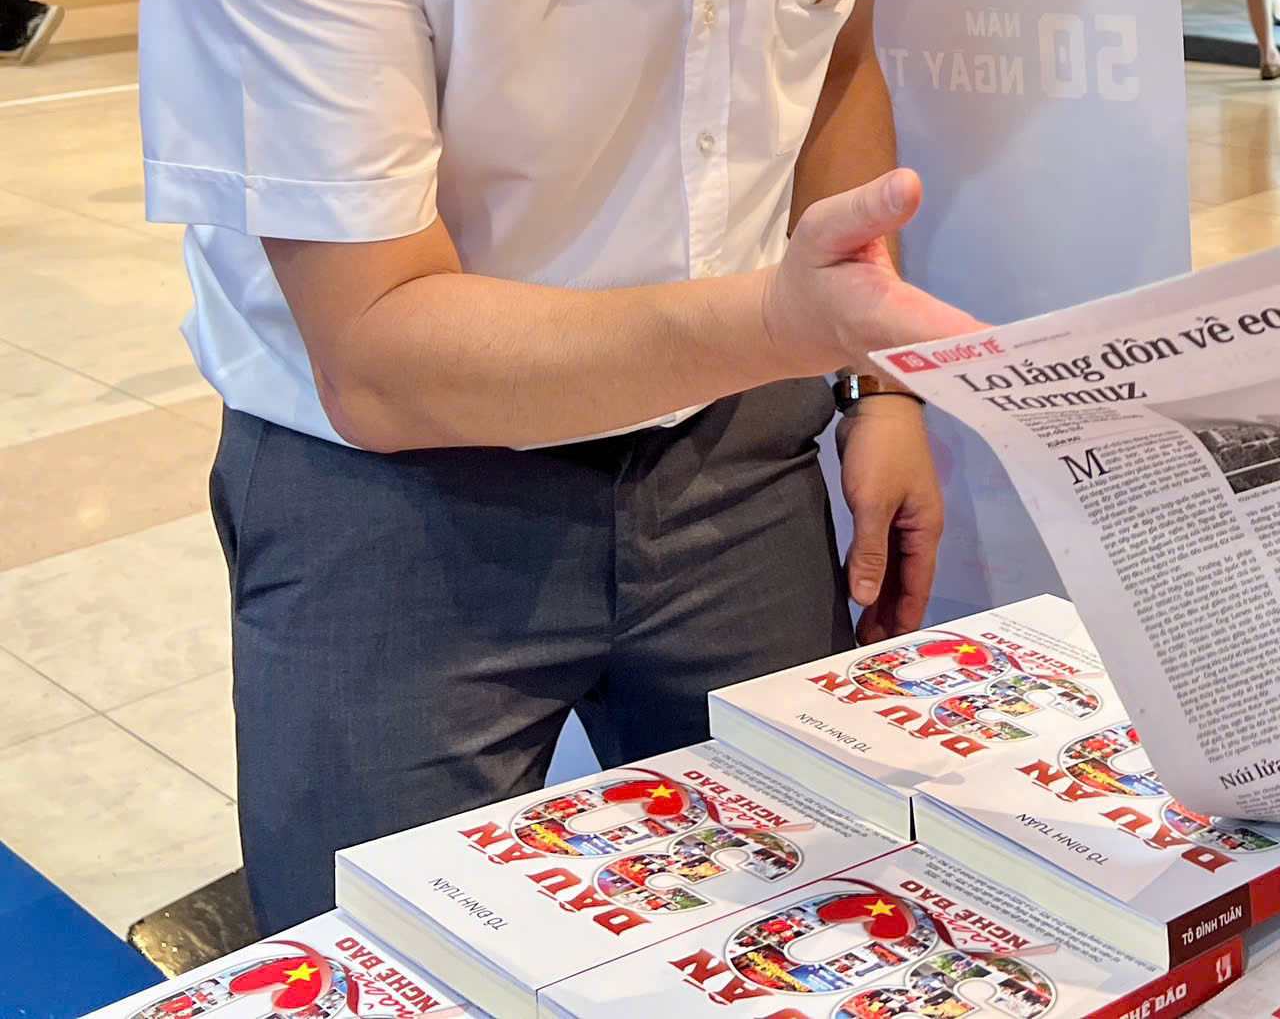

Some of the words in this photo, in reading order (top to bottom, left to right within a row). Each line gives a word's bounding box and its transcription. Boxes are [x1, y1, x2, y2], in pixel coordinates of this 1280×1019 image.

[932, 344, 983, 367] QUỐC
[979, 335, 1007, 355] TẾ
[953, 372, 1013, 393] Lo
[1004, 358, 1105, 386] lắng
[1101, 336, 1184, 371] dồn
[1178, 316, 1235, 349] về
[983, 381, 1148, 412] Hormuz
[981, 632, 1025, 651] BÁO
[805, 670, 888, 704] ẤN
[798, 712, 829, 731] TUẤN
[827, 727, 857, 744] ĐÌNH
[872, 705, 991, 758] DẤU
[853, 741, 873, 754] TÔ
[682, 770, 733, 797] BÁO
[1015, 759, 1110, 803] ẤN
[1219, 769, 1257, 790] Núi
[725, 792, 792, 829] NGHỀ
[1016, 813, 1052, 837] TUẤN
[457, 821, 550, 865] ẤN
[1052, 831, 1091, 854] ĐÌNH
[1099, 806, 1238, 873] DẤU
[1087, 851, 1110, 866] TÔ
[428, 876, 466, 901] TUẤN
[524, 867, 653, 936] DẤU
[899, 880, 958, 917] BÁO
[460, 896, 498, 921] ĐÌNH
[483, 913, 510, 931] TÔ
[954, 907, 1031, 951] NGHỀ
[1182, 930, 1194, 946] TÔ
[1195, 917, 1219, 941] ĐÌNH
[1218, 905, 1243, 927] TUẤN
[334, 936, 386, 971] BÁO
[374, 967, 441, 1013] NGHỀ
[667, 948, 776, 1007] ẤN
[1155, 982, 1188, 1013] BÁO
